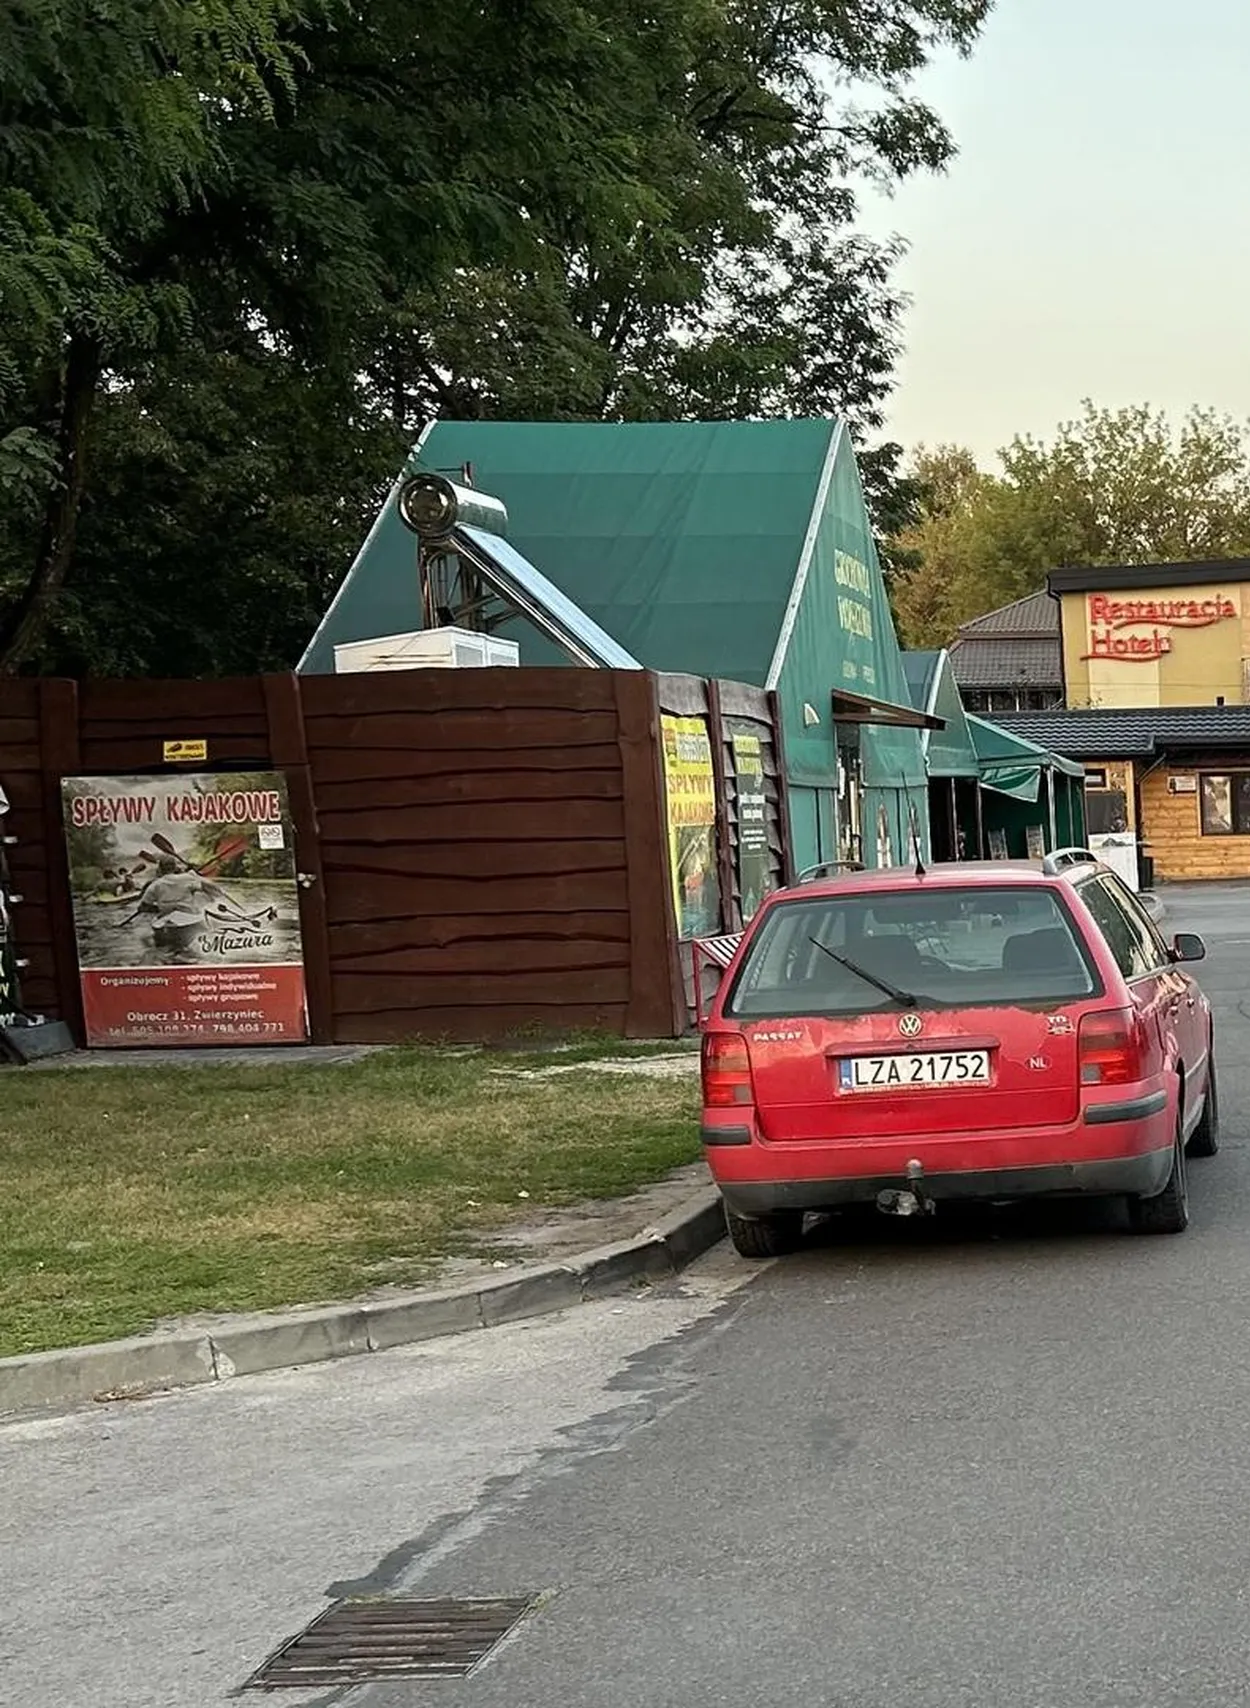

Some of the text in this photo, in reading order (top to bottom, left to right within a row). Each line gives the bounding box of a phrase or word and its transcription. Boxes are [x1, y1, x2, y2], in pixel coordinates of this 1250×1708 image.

[1088, 594, 1238, 625] Restauracja
[1091, 629, 1167, 656] Hotel
[73, 791, 280, 826] SPŁYWY KAJAKOWE
[193, 1009, 265, 1021] Zwierzyniec
[753, 1031, 802, 1042] PASSAT
[855, 1060, 901, 1086] LZA
[910, 1054, 985, 1082] 21752
[1029, 1058, 1047, 1069] NL
